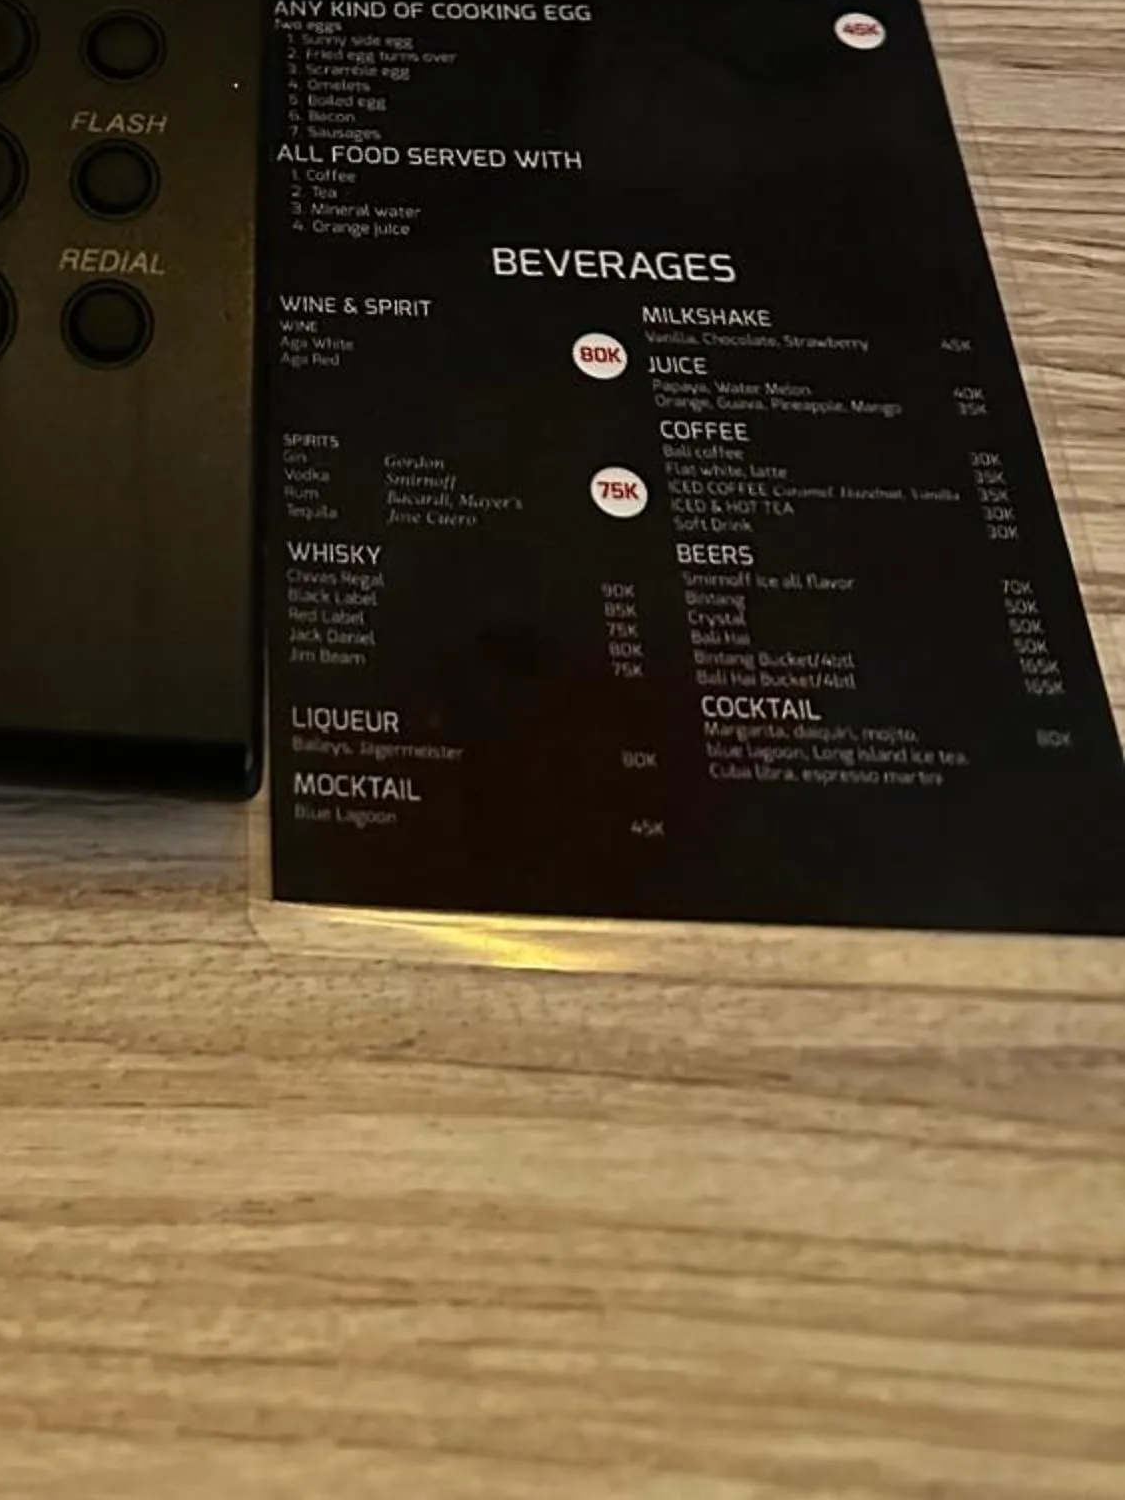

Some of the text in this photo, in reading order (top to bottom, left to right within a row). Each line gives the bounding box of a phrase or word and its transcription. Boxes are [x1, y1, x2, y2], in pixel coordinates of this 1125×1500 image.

[275, 0, 592, 21] ANY KIND OF COOKING EGG
[70, 110, 168, 134] FLASH
[276, 144, 583, 171] ALL FOOD SERVED WITH
[306, 169, 357, 184] Coffee
[311, 185, 338, 199] Tea
[311, 203, 422, 219] Mineral water
[312, 219, 411, 238] Orange juice
[59, 248, 165, 276] REDIAL
[491, 247, 736, 284] BEVERAGES
[279, 296, 432, 318] WINE & SPIRIT
[279, 320, 319, 333] WINE
[641, 306, 773, 328] MILKSHAKE
[311, 337, 355, 352] White
[312, 354, 341, 367] Red
[580, 347, 622, 364] 80K
[647, 356, 708, 375] JUICE
[659, 420, 750, 441] COFFEE
[281, 433, 341, 449] SPIRITS
[283, 467, 330, 483] Vodka
[597, 482, 639, 500] 75K
[706, 481, 768, 498] COFFEE
[725, 500, 760, 515] HOT
[286, 541, 382, 565] WHISKY
[676, 543, 754, 566] BEERS
[700, 695, 822, 721] COCKTAIL
[291, 705, 400, 734] LIQUEUR
[293, 772, 422, 802] MOCKTAIL
